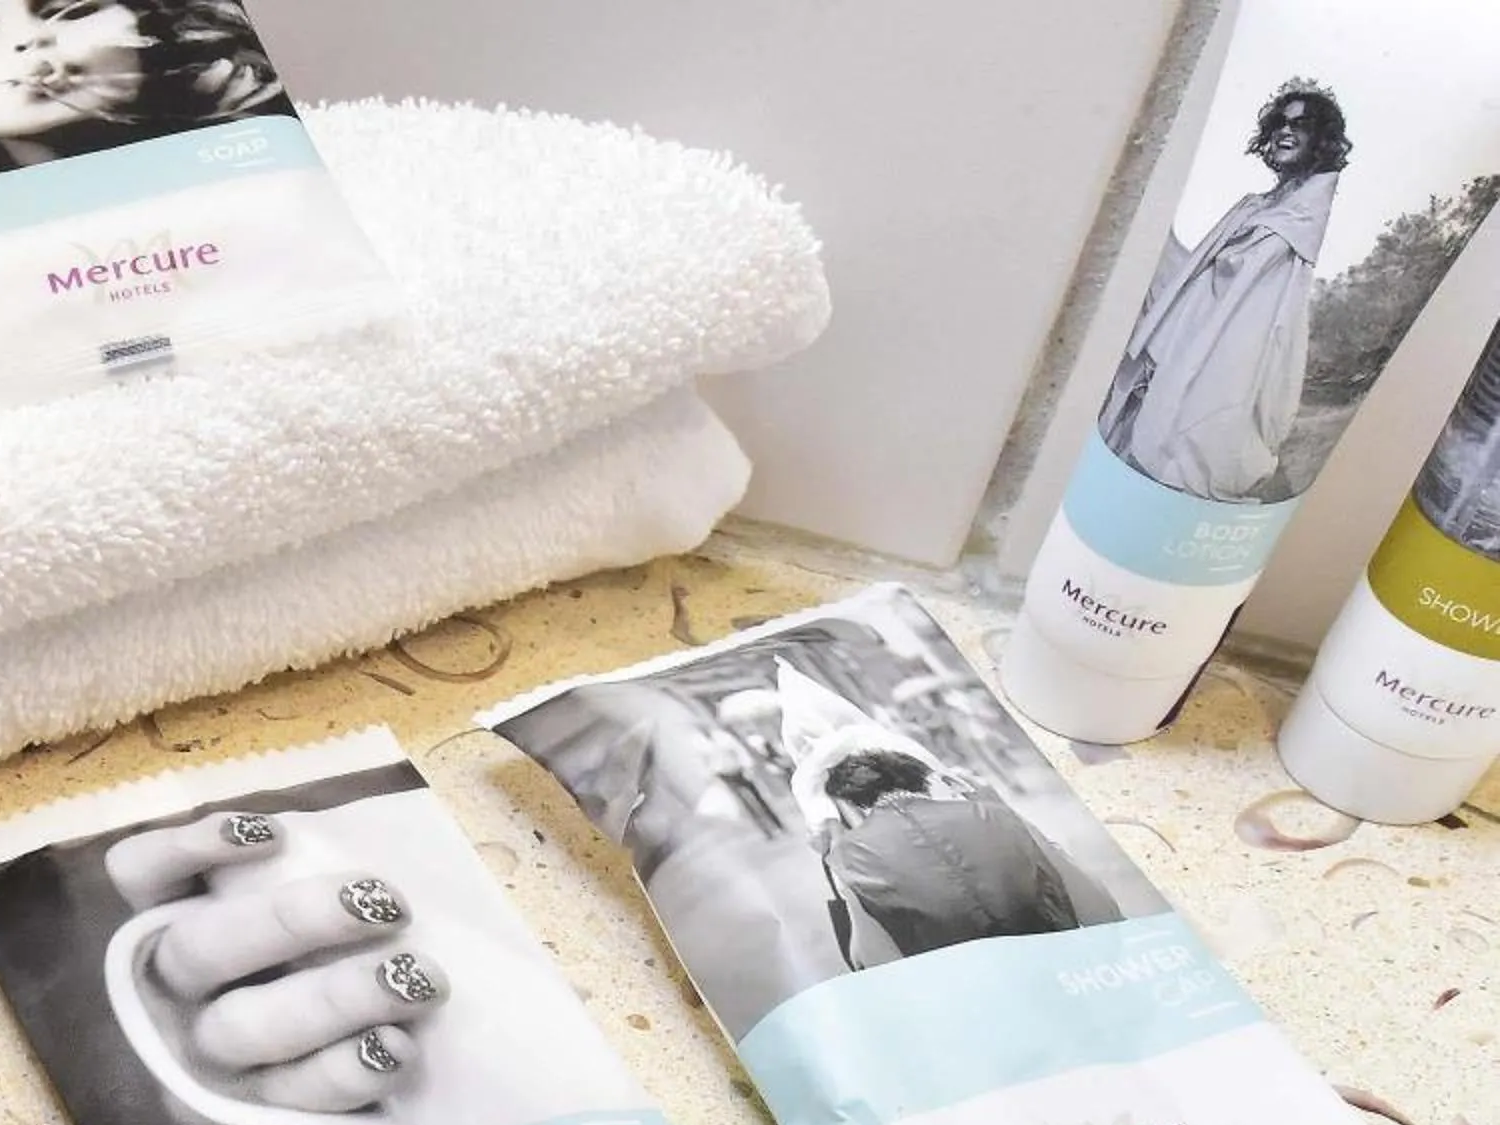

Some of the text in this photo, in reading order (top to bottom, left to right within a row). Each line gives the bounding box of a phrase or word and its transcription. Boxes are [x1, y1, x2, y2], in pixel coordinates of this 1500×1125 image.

[198, 136, 268, 164] SOAP
[46, 242, 221, 295] Mercure
[109, 281, 171, 302] HOTELS
[1194, 522, 1263, 541] BODY
[1061, 578, 1168, 636] Mercure
[1418, 587, 1500, 634] SHOW
[1375, 670, 1496, 719] Mercure
[1057, 945, 1198, 996] SHOWER
[1155, 969, 1217, 1006] CAP
